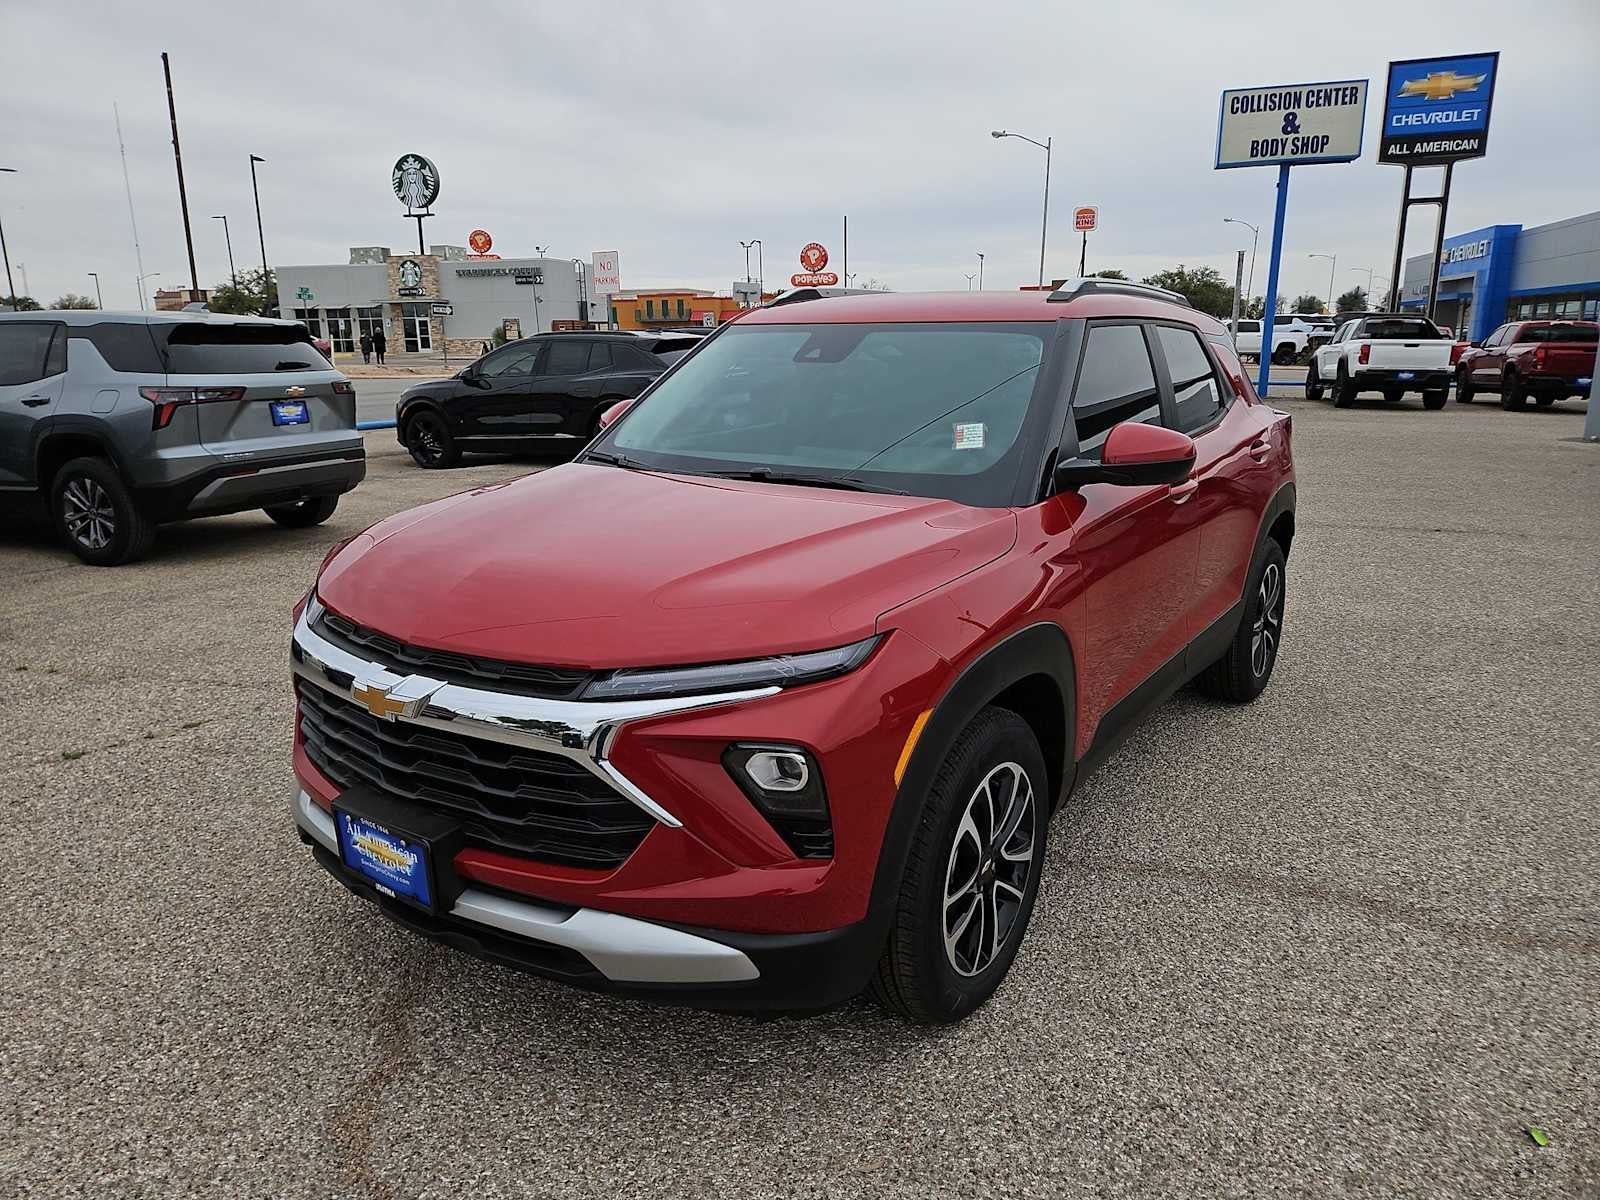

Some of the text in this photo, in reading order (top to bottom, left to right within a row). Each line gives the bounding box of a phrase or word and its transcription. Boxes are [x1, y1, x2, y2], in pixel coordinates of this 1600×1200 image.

[1230, 86, 1359, 114] COLLISION CENTER
[1281, 112, 1301, 135] &
[1391, 109, 1482, 127] CHEVROLET
[1250, 135, 1329, 158] BODY SHOP
[1388, 139, 1479, 156] ALL AMERICAN
[1449, 239, 1489, 263] CHEVROLET
[599, 260, 612, 271] NO
[592, 276, 619, 286] PARKING
[346, 822, 419, 864] All American
[356, 842, 413, 877] Chevrolet
